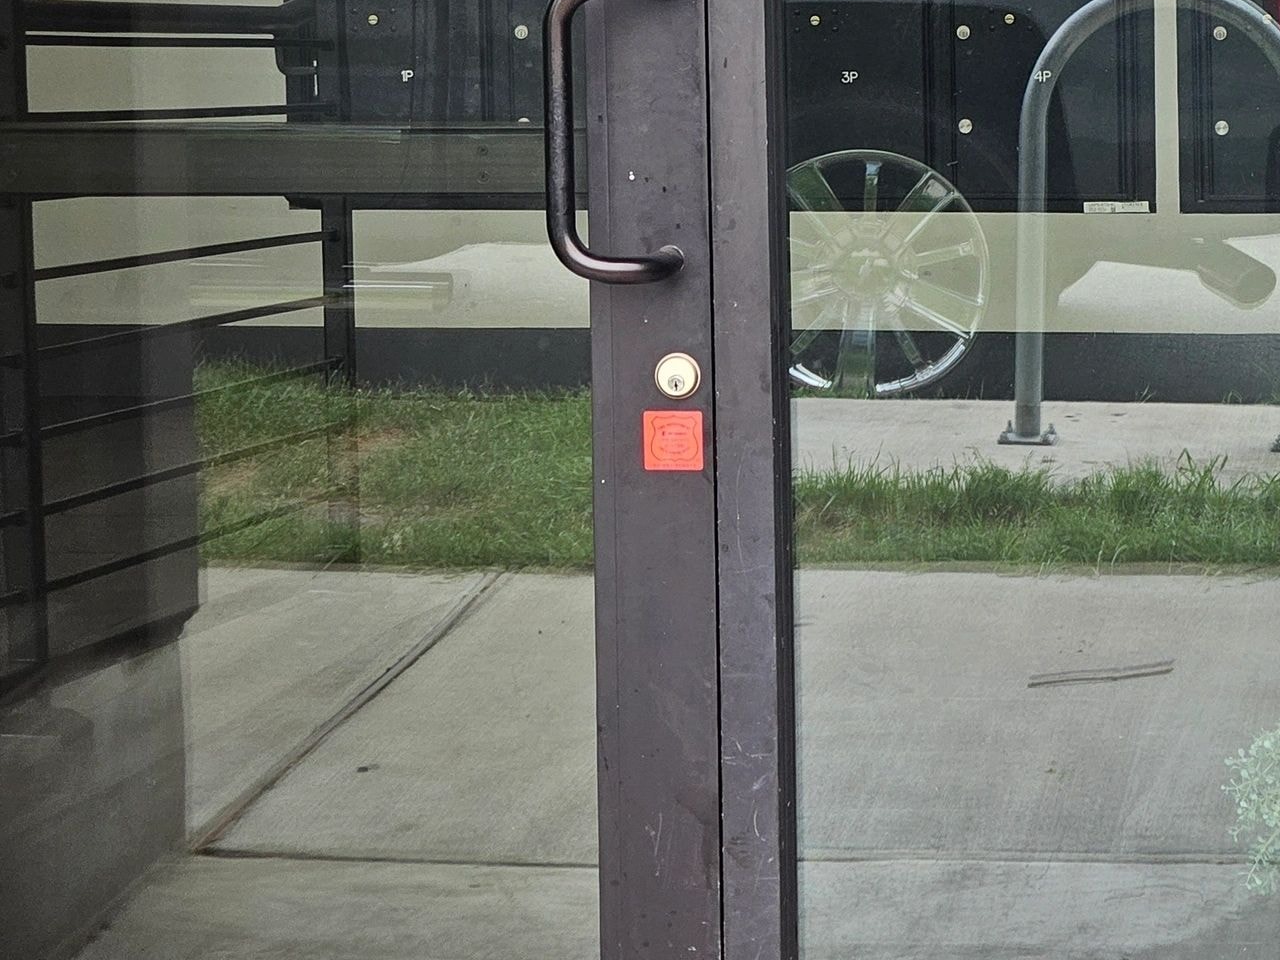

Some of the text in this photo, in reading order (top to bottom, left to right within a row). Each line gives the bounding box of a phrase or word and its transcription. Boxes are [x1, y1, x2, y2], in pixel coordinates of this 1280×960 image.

[400, 69, 414, 82] 1P
[841, 71, 859, 84] 3P
[1033, 70, 1052, 83] 4P
